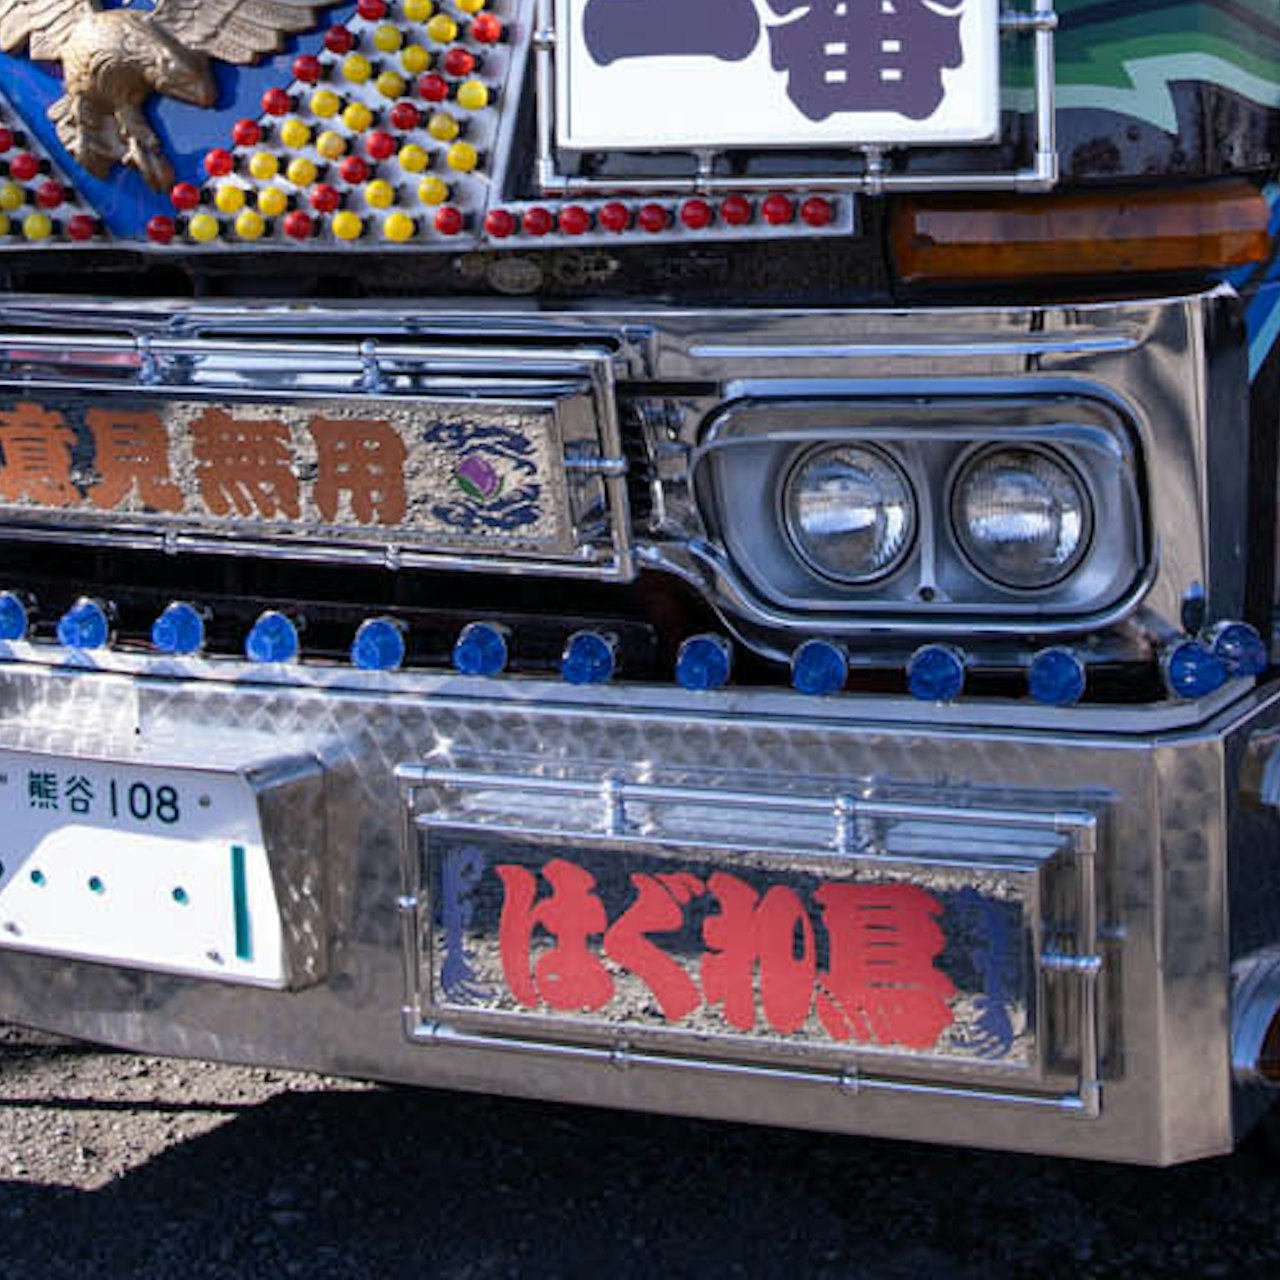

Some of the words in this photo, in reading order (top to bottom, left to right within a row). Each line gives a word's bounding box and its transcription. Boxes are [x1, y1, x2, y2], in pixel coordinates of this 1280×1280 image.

[28, 770, 94, 814] 熊谷
[109, 780, 180, 824] 108
[496, 859, 960, 1050] はぐれ鳥
